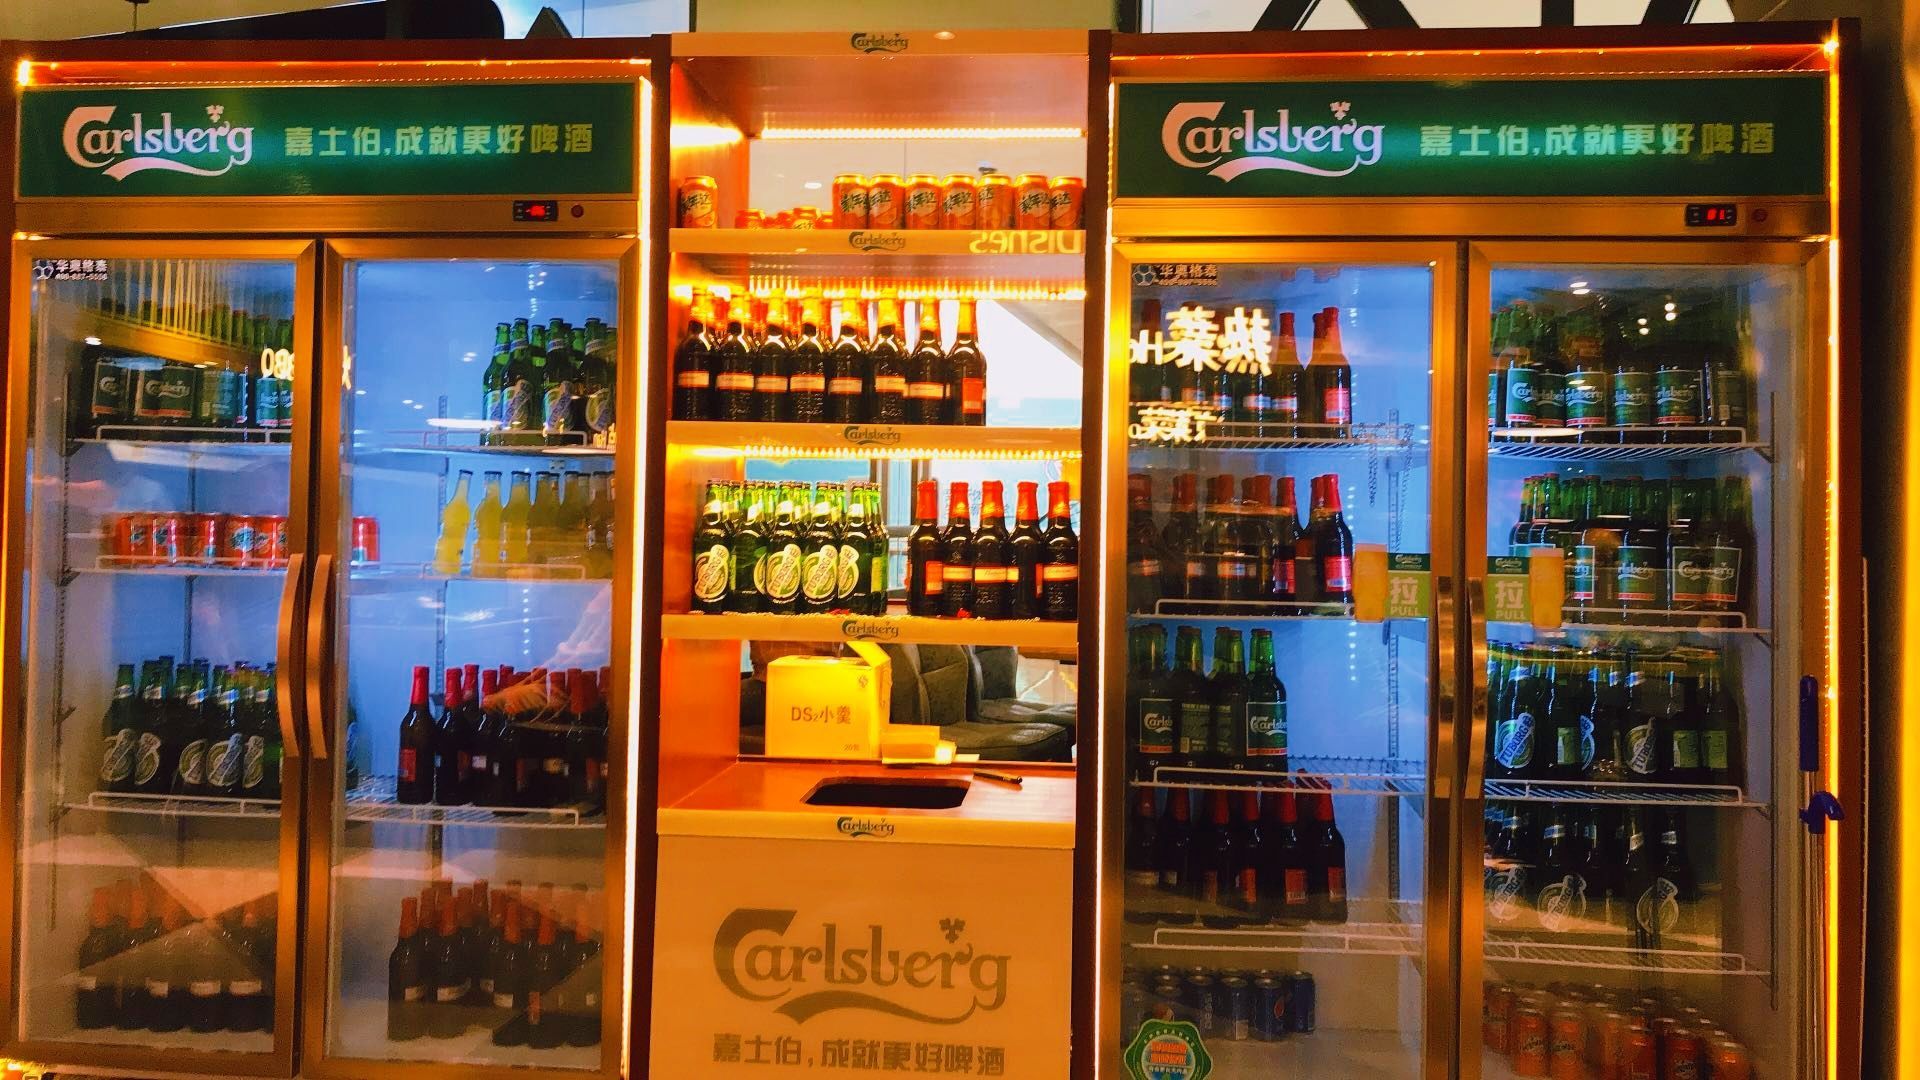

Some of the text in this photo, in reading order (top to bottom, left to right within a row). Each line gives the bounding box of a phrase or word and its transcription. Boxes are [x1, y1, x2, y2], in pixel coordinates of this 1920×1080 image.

[851, 33, 909, 52] Carlsberg
[62, 105, 254, 180] Carlsberg
[1162, 102, 1385, 180] Carlsberg
[849, 231, 906, 251] Carlsberg
[843, 425, 901, 445] Carlsberg
[1390, 576, 1418, 605] 拉
[1495, 580, 1524, 608] 拉
[1390, 606, 1421, 617] PULL
[1496, 610, 1527, 620] PULL
[842, 619, 899, 639] Carlsberg
[837, 816, 895, 838] Carlsberg
[713, 907, 1011, 1021] Carlsberg
